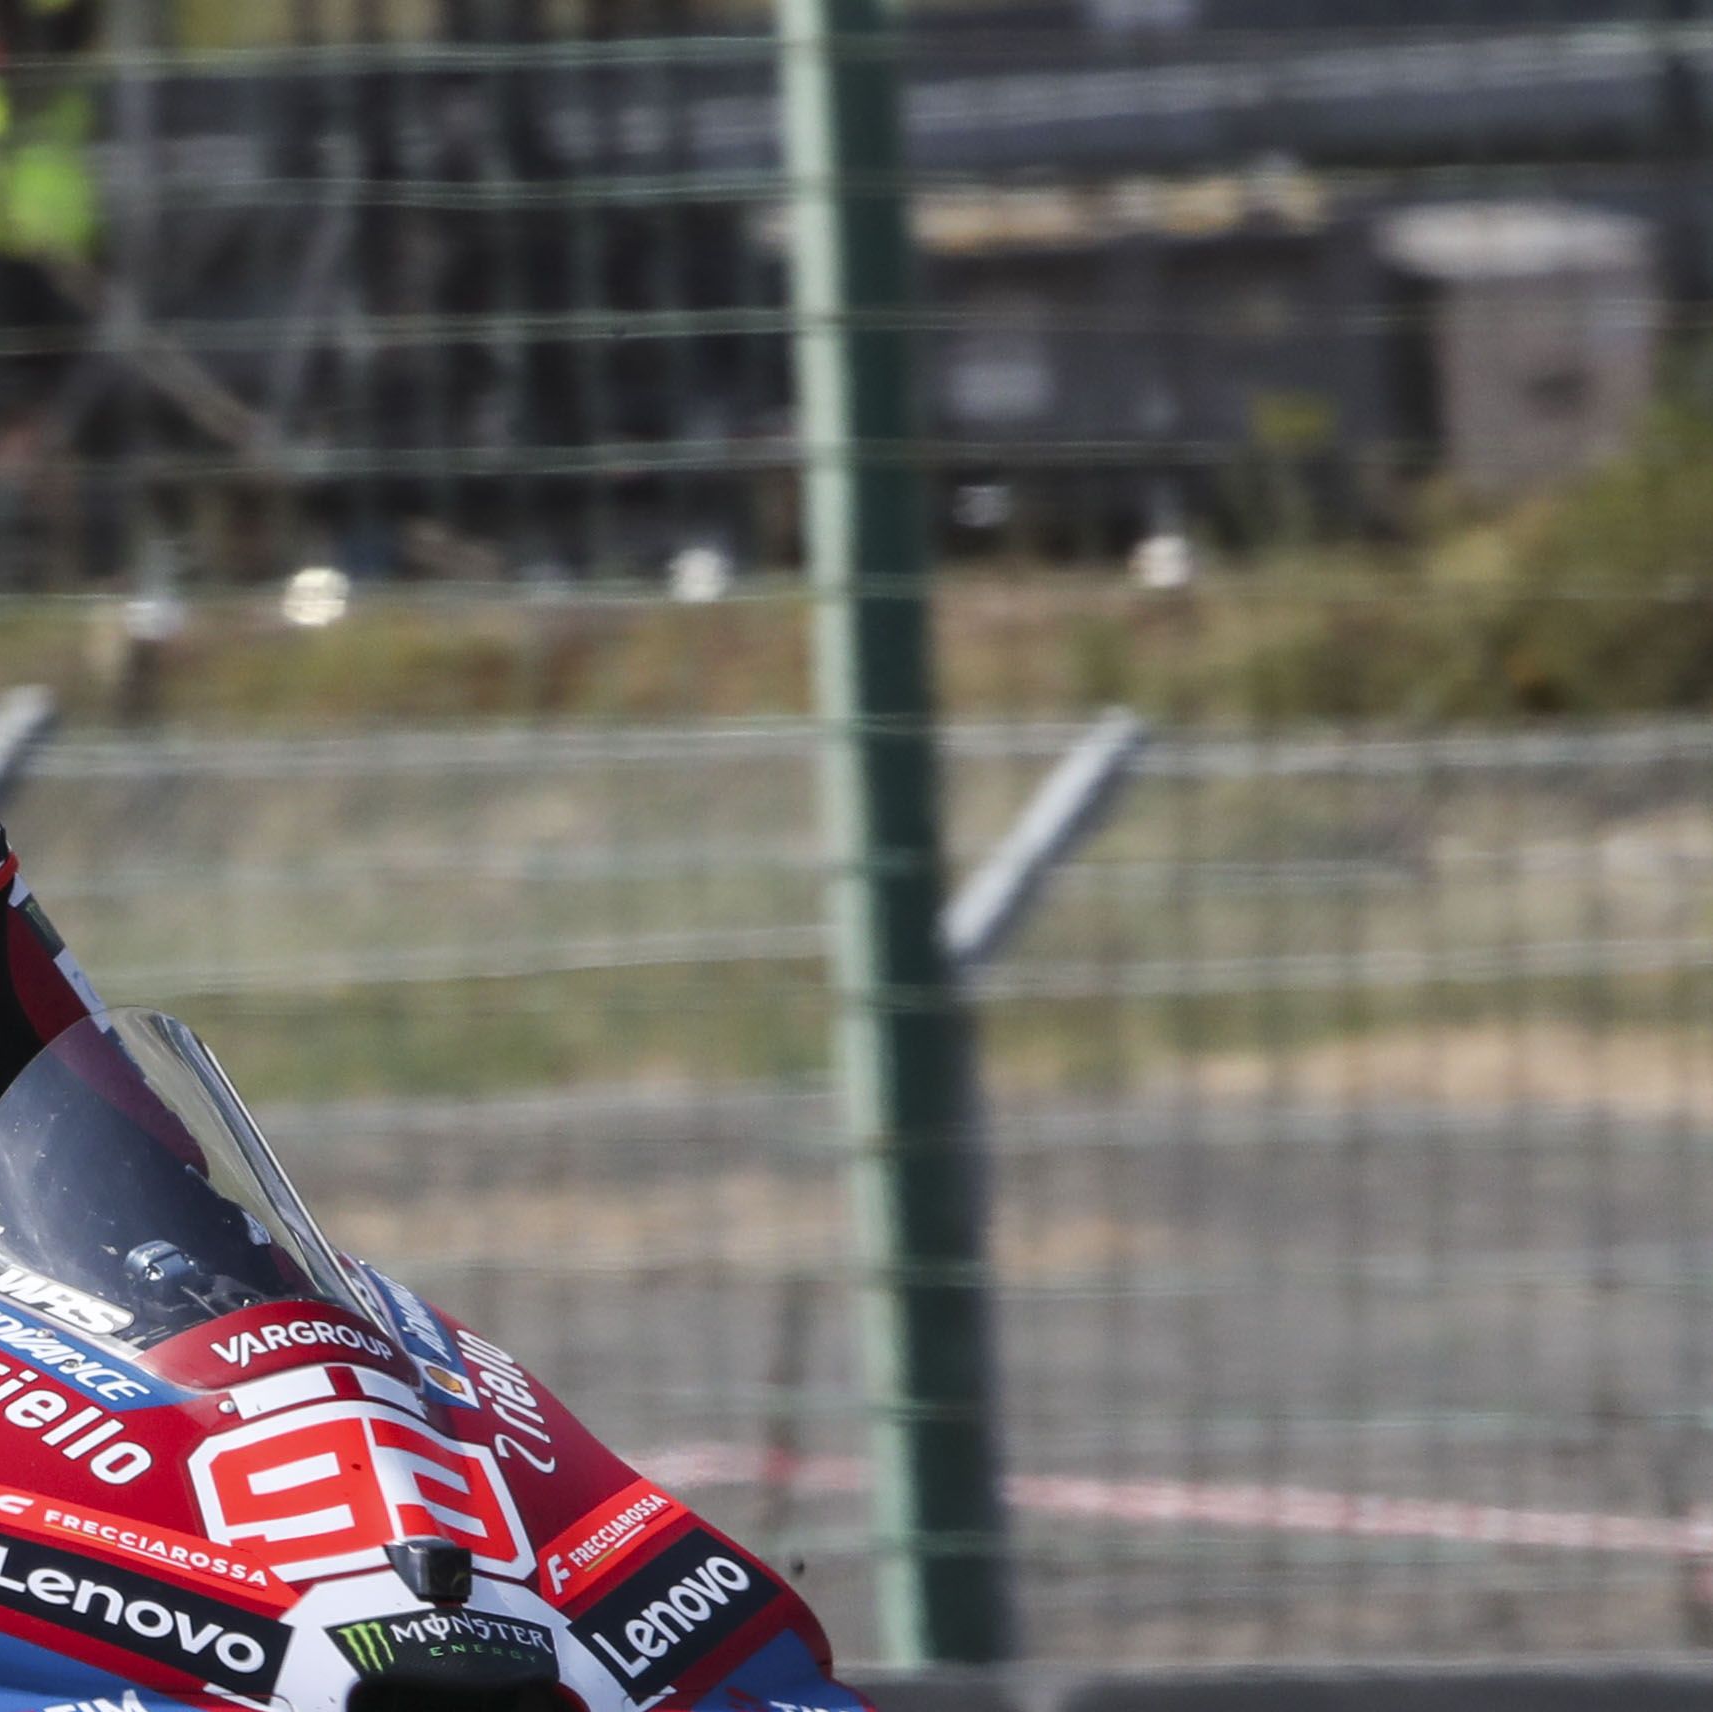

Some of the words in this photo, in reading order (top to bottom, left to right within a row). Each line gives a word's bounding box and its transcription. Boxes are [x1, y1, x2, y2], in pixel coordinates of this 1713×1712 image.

[43, 1508, 269, 1588] FRECCIAROSSA
[567, 1491, 670, 1571] FRECCIAROSSA
[389, 1612, 554, 1656] MONSTER
[590, 1552, 753, 1681] Lenovo
